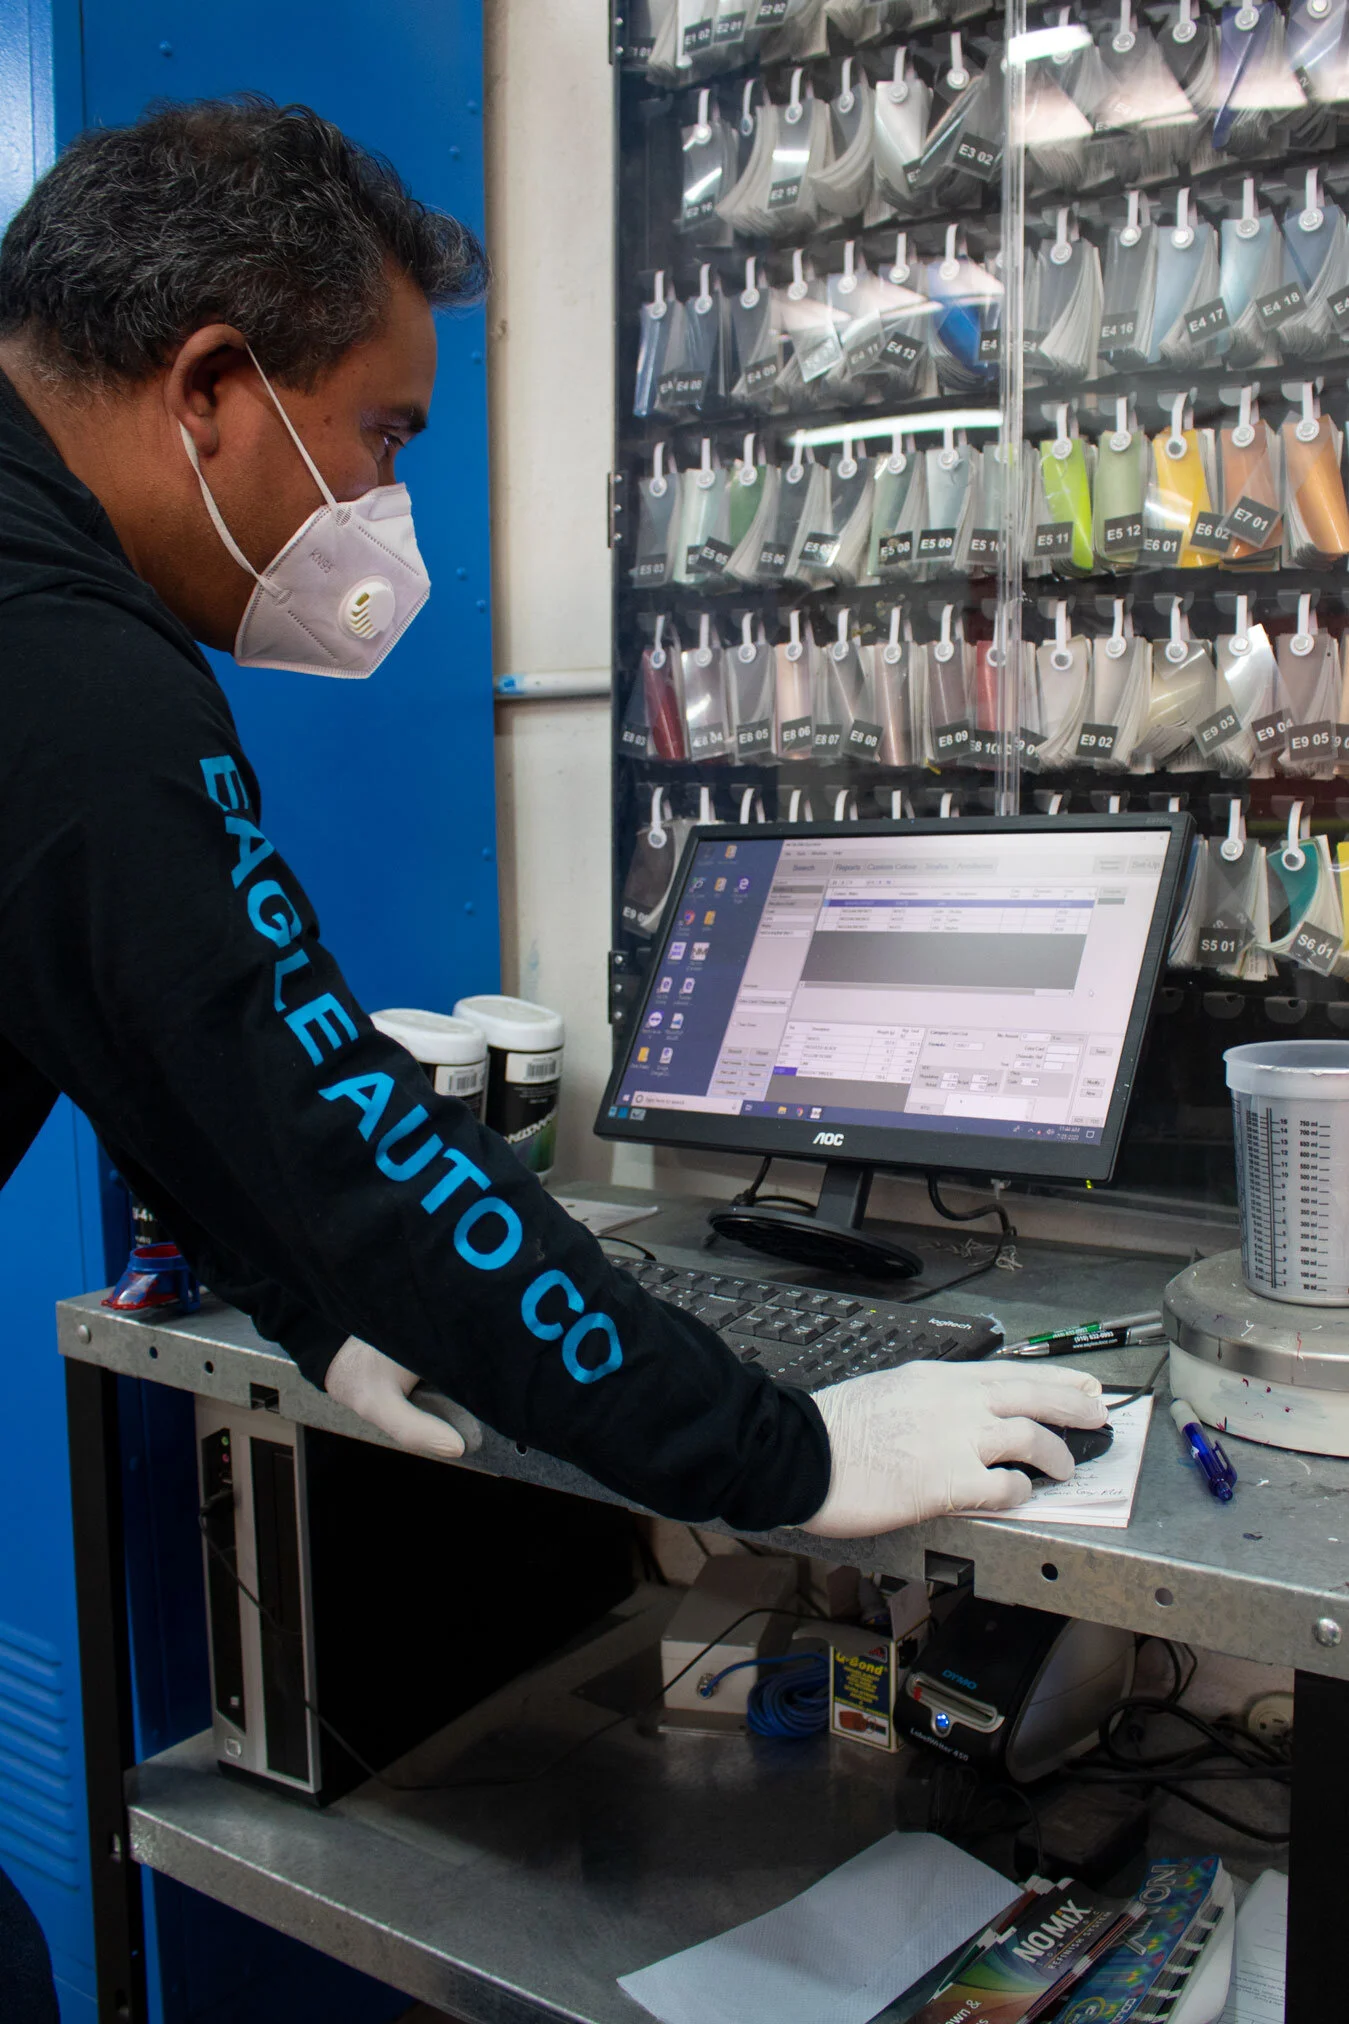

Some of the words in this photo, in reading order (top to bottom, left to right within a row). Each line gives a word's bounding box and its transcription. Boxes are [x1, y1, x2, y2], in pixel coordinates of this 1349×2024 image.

[958, 143, 975, 158] E3
[976, 150, 994, 165] 02
[1262, 301, 1282, 317] E4
[1283, 292, 1301, 307] 18
[1188, 317, 1207, 334] E4
[1208, 307, 1225, 323] 17
[1101, 325, 1117, 338] E4
[1119, 322, 1134, 336] 16
[886, 341, 903, 354] E4
[902, 347, 917, 360] 13
[981, 340, 997, 351] E4
[1234, 508, 1252, 525] E7
[1252, 515, 1268, 532] 01
[1037, 534, 1054, 546] E5
[1055, 532, 1069, 544] 11
[1107, 528, 1124, 541] E5
[1125, 524, 1141, 537] 12
[1195, 523, 1212, 535] E6
[1212, 527, 1229, 540] 02
[805, 542, 819, 552] E5
[880, 544, 894, 557] E5
[897, 541, 910, 553] 08
[920, 538, 936, 549] E5
[938, 537, 952, 548] 09
[971, 539, 987, 550] E5
[1144, 539, 1160, 551] E6
[1161, 540, 1177, 552] 01
[701, 546, 715, 560] E5
[715, 552, 729, 566] 05
[761, 552, 773, 562] E5
[739, 732, 753, 744] E8
[754, 729, 769, 741] 05
[783, 730, 796, 742] E8
[797, 726, 811, 738] 06
[1202, 726, 1219, 742] E9
[1219, 715, 1236, 730] 03
[1257, 726, 1275, 742] E9
[1276, 718, 1293, 732] 04
[816, 734, 827, 745] E8
[827, 734, 839, 746] 07
[851, 730, 865, 743] E8
[865, 734, 878, 747] 08
[939, 735, 953, 748] E8
[954, 730, 969, 743] 09
[1080, 734, 1095, 746] E9
[1098, 736, 1113, 748] 02
[1292, 735, 1310, 749] E9
[1312, 732, 1329, 746] 05
[1202, 939, 1218, 951] S5
[1220, 940, 1235, 952] 01
[1297, 934, 1316, 949] S6
[1316, 943, 1334, 959] 01
[199, 754, 359, 1067] EAGLE
[317, 1071, 523, 1270] AUTO
[521, 1268, 623, 1385] CO
[813, 1131, 845, 1148] AOC
[928, 1317, 972, 1330] logitech
[941, 1669, 978, 1690] DYMO
[953, 1749, 969, 1762] 450
[966, 1999, 982, 2009] &
